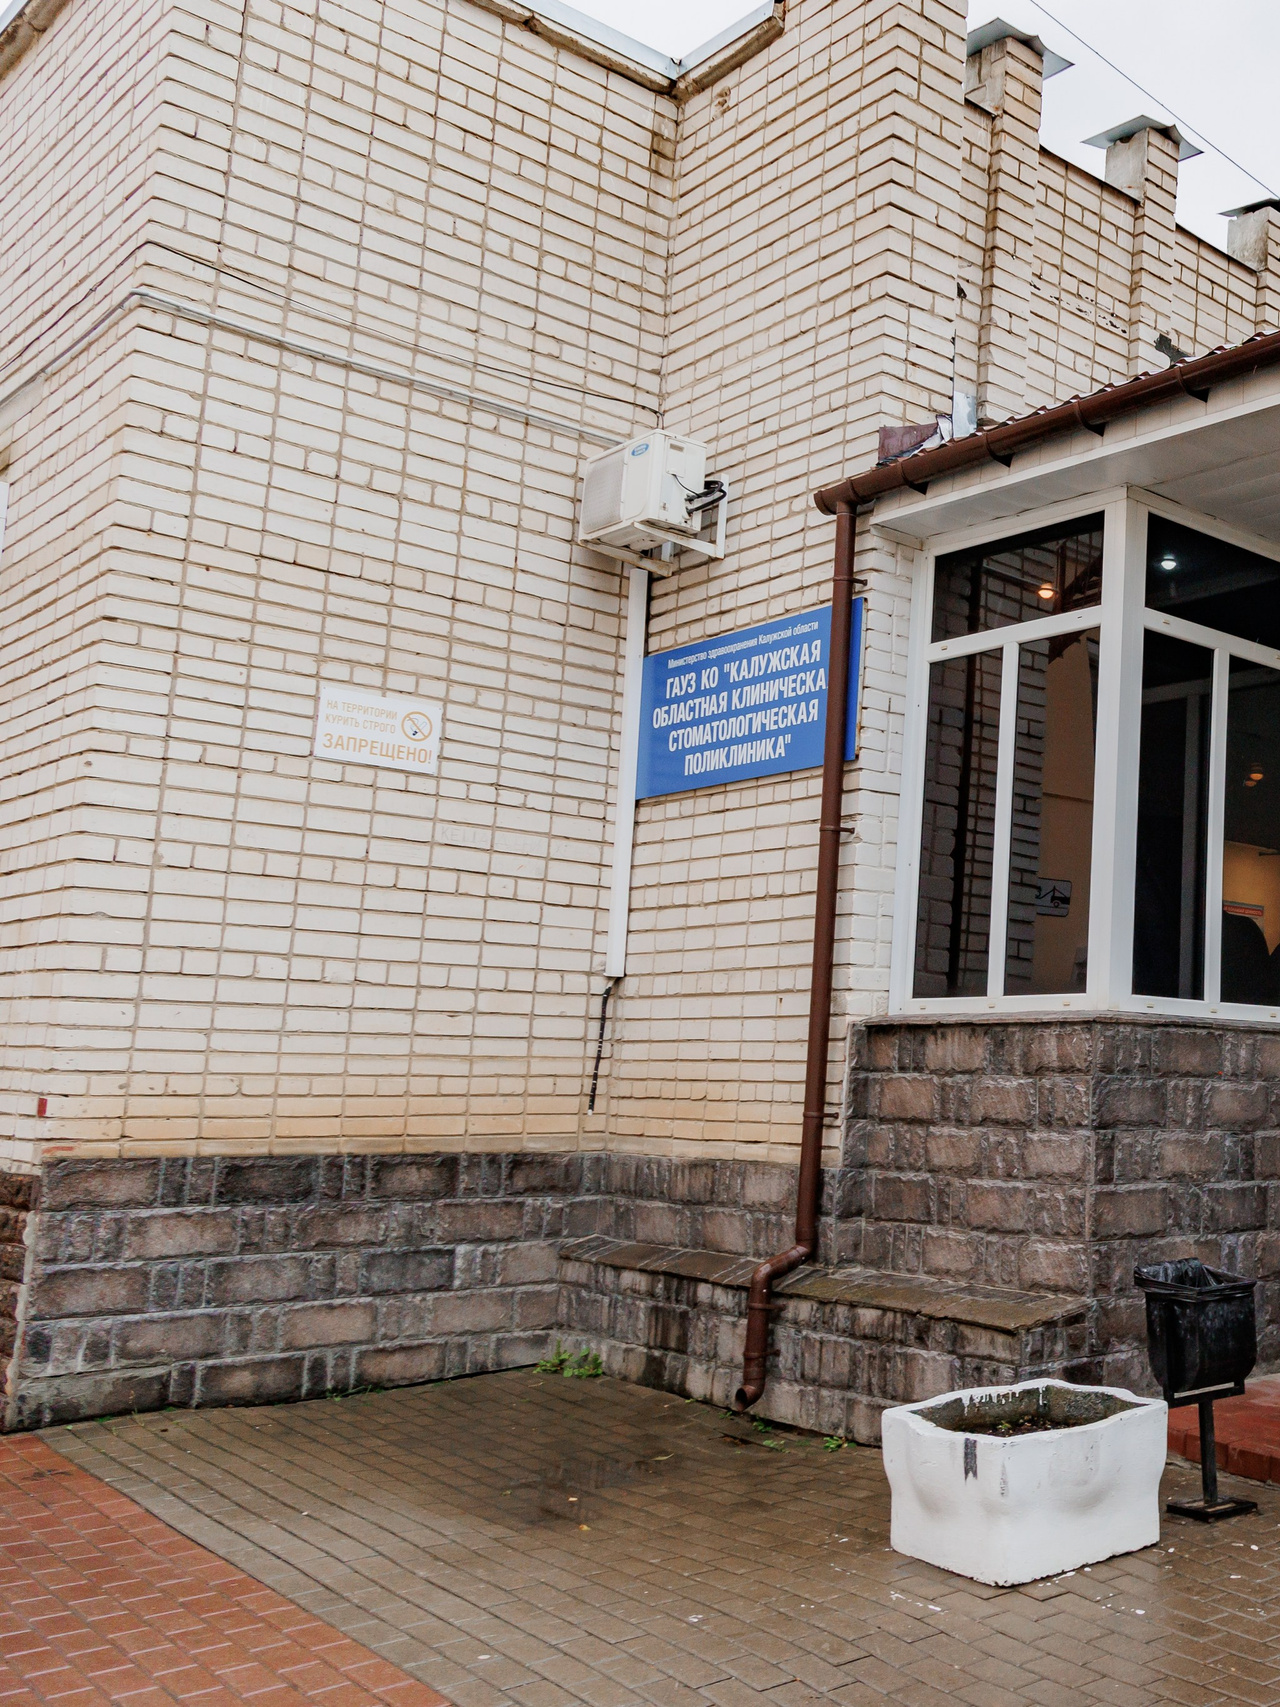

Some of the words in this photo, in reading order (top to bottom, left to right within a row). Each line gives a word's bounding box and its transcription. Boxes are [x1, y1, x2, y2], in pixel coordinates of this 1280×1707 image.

[668, 652, 706, 670] Министерство
[708, 638, 758, 660] здравоохранения
[758, 627, 792, 645] Калужской
[793, 621, 818, 636] области
[666, 672, 696, 699] ГАУЗ
[700, 666, 719, 690] КО
[724, 640, 822, 683] "КАЛУЖСКАЯ
[326, 700, 338, 710] НА
[342, 702, 398, 721] ТЕРРИТОРИИ
[652, 691, 728, 729] ОБЛАСТНАЯ
[732, 668, 828, 711] КЛИНИЧЕСКА
[325, 713, 360, 728] КУРИТЬ
[362, 719, 396, 734] СТРОГО
[668, 698, 819, 752] СТОМАТОЛОГИЧЕСКАЯ
[322, 732, 432, 764] ЗАПРЕЩЕНО!
[684, 734, 791, 776] ПОЛИКЛИНИКА"
